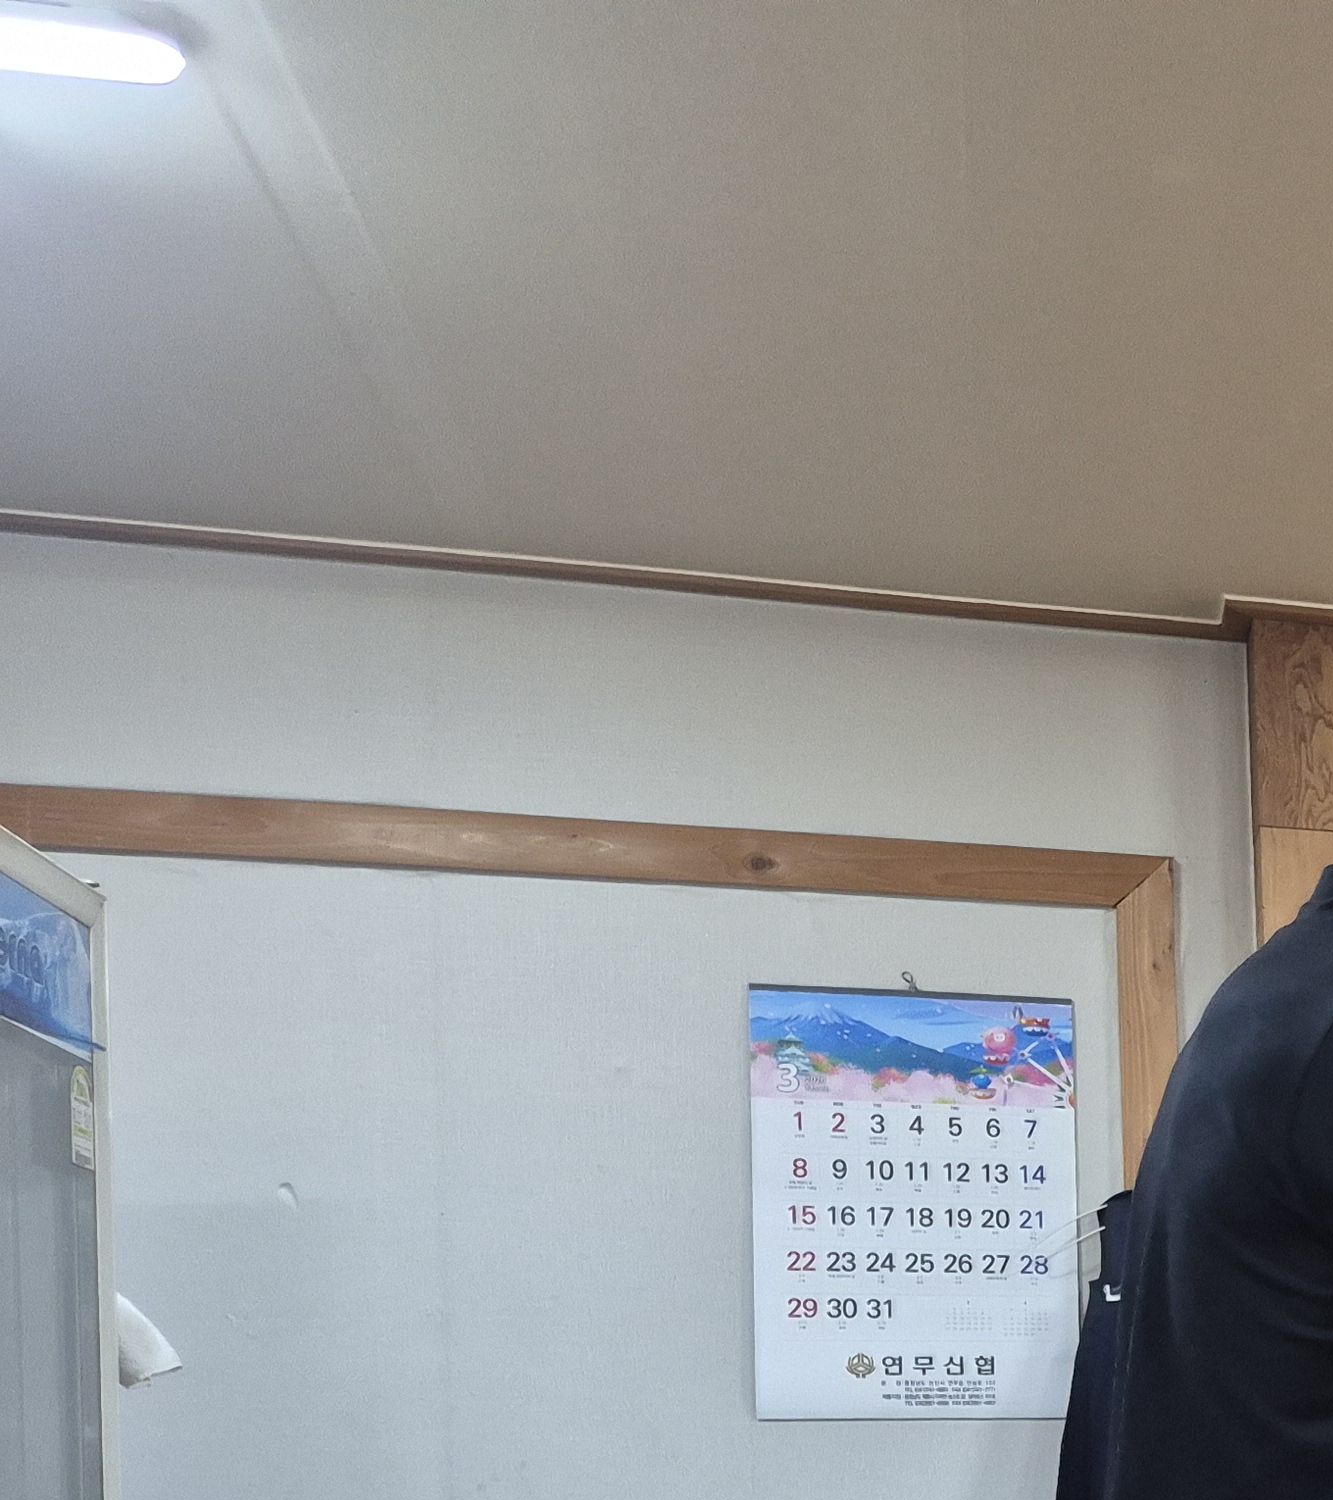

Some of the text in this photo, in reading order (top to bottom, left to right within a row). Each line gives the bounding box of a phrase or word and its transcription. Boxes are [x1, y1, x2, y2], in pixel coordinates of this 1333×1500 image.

[776, 1063, 800, 1093] 3
[793, 1111, 1037, 1139] 1 2 3 4 5 6 7
[792, 1157, 1047, 1185] 8 9 10 11 12 13 14
[787, 1204, 1043, 1230] 15 16 17 18 19 20 21
[786, 1250, 1049, 1275] 22 23 24 25 26 27 28
[787, 1297, 892, 1320] 29 30 31
[881, 1355, 995, 1376] 연무신협
